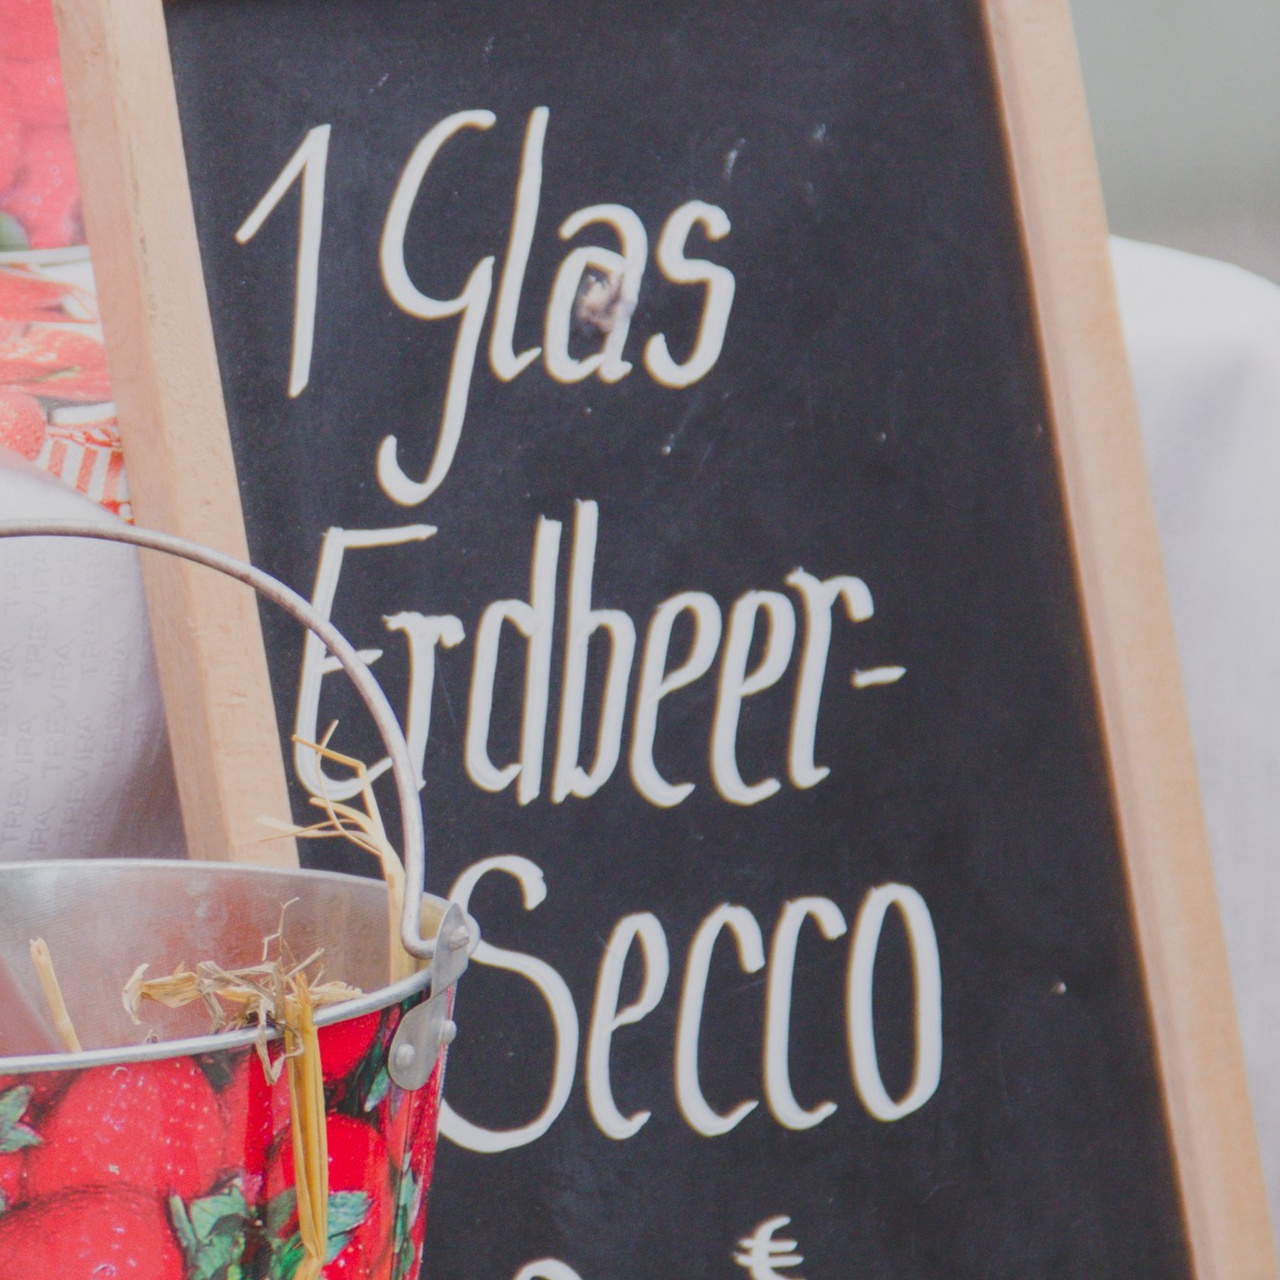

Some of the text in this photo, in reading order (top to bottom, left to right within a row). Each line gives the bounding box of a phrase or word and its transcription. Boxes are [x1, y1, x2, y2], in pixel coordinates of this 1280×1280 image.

[236, 105, 737, 506] 1 Glas
[294, 498, 908, 808] Erdbeer-
[437, 854, 942, 1154] Secco
